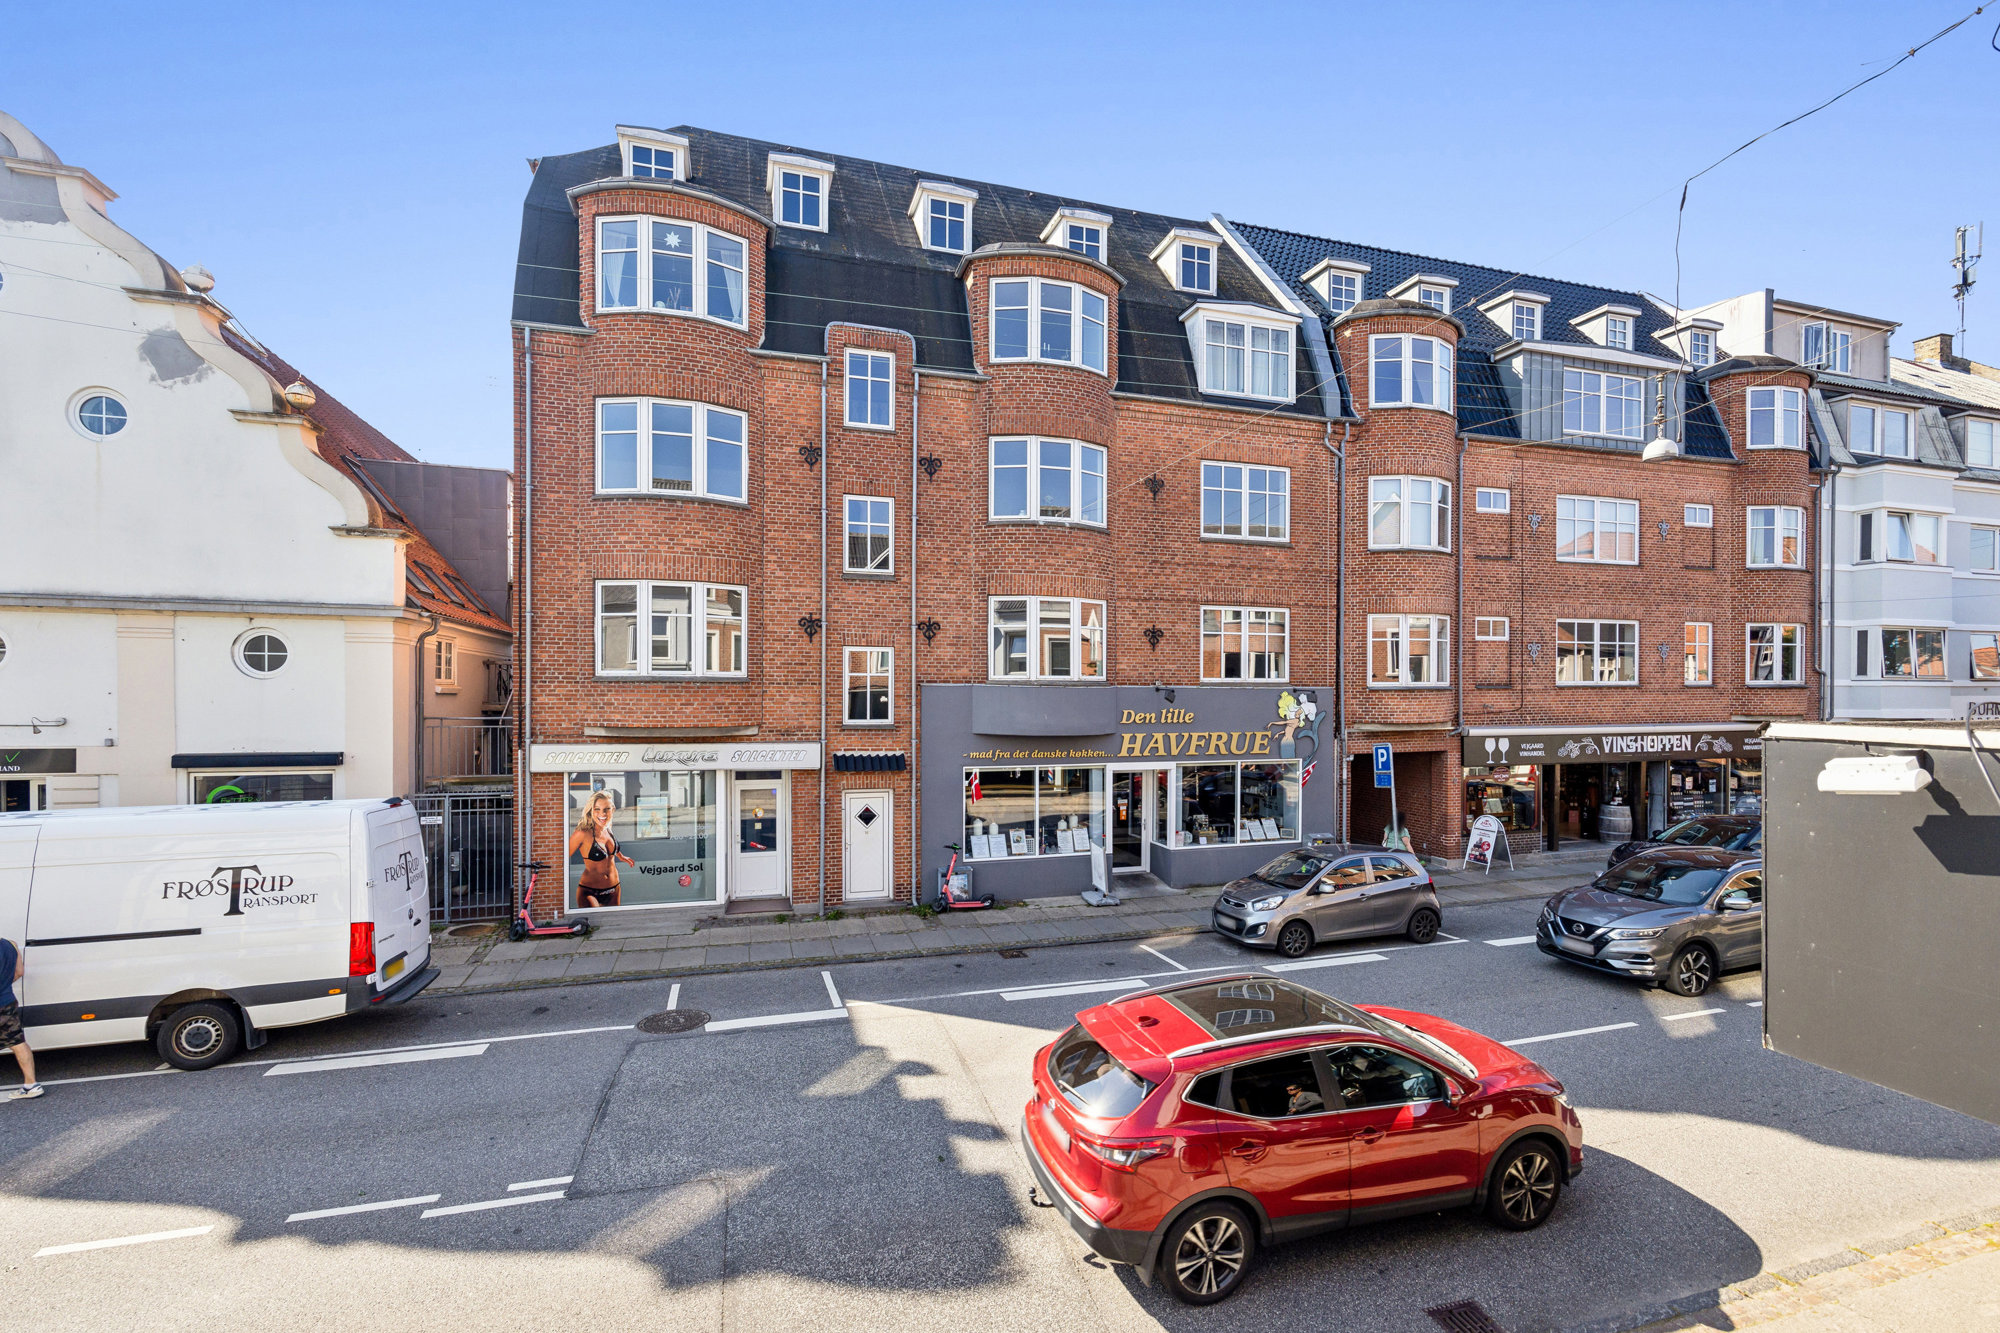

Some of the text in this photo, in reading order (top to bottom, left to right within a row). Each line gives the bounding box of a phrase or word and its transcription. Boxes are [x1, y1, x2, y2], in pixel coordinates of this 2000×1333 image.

[1120, 708, 1195, 724] Den lille
[1117, 731, 1272, 757] HAVFRUE
[1601, 735, 1692, 753] VINSHOPPEN
[544, 751, 630, 765] SOLCENTER
[731, 749, 807, 763] SOLCENTER
[969, 750, 993, 759] mad
[992, 749, 1011, 762] fra
[1013, 749, 1029, 758] det
[1031, 749, 1067, 759] danske
[1377, 748, 1388, 769] P
[639, 862, 704, 876] Vejgaard Sol
[162, 865, 294, 916] FRØSTRUP
